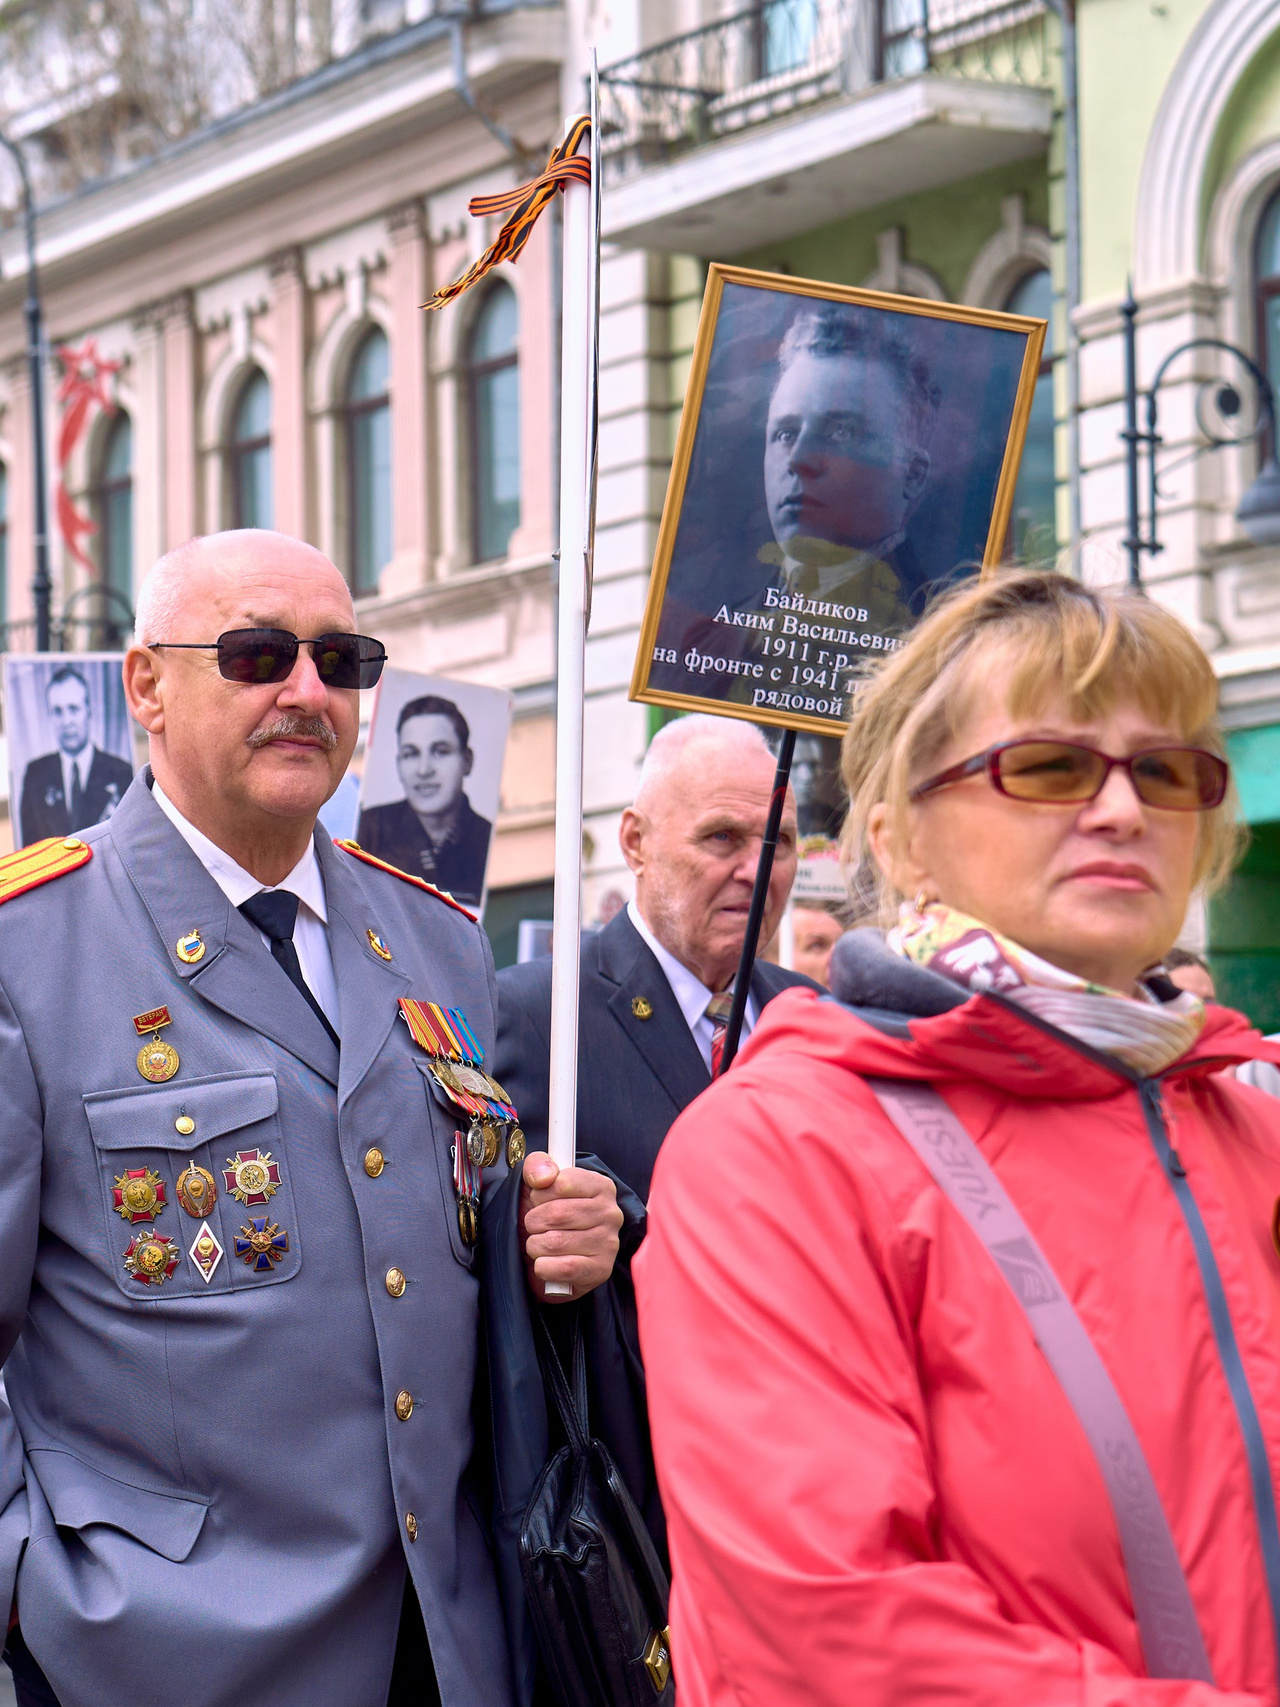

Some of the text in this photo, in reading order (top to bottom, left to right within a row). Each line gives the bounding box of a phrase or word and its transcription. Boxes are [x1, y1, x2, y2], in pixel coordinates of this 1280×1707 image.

[712, 604, 774, 632] Аким
[764, 587, 869, 623] Байдиков
[652, 646, 677, 664] на
[684, 647, 763, 678] фронте
[769, 667, 781, 681] с
[790, 665, 838, 691] 1941
[761, 636, 853, 672] 1911 г.р.
[752, 688, 843, 716] рядовой
[138, 1010, 164, 1024] ВЕТЕРАН
